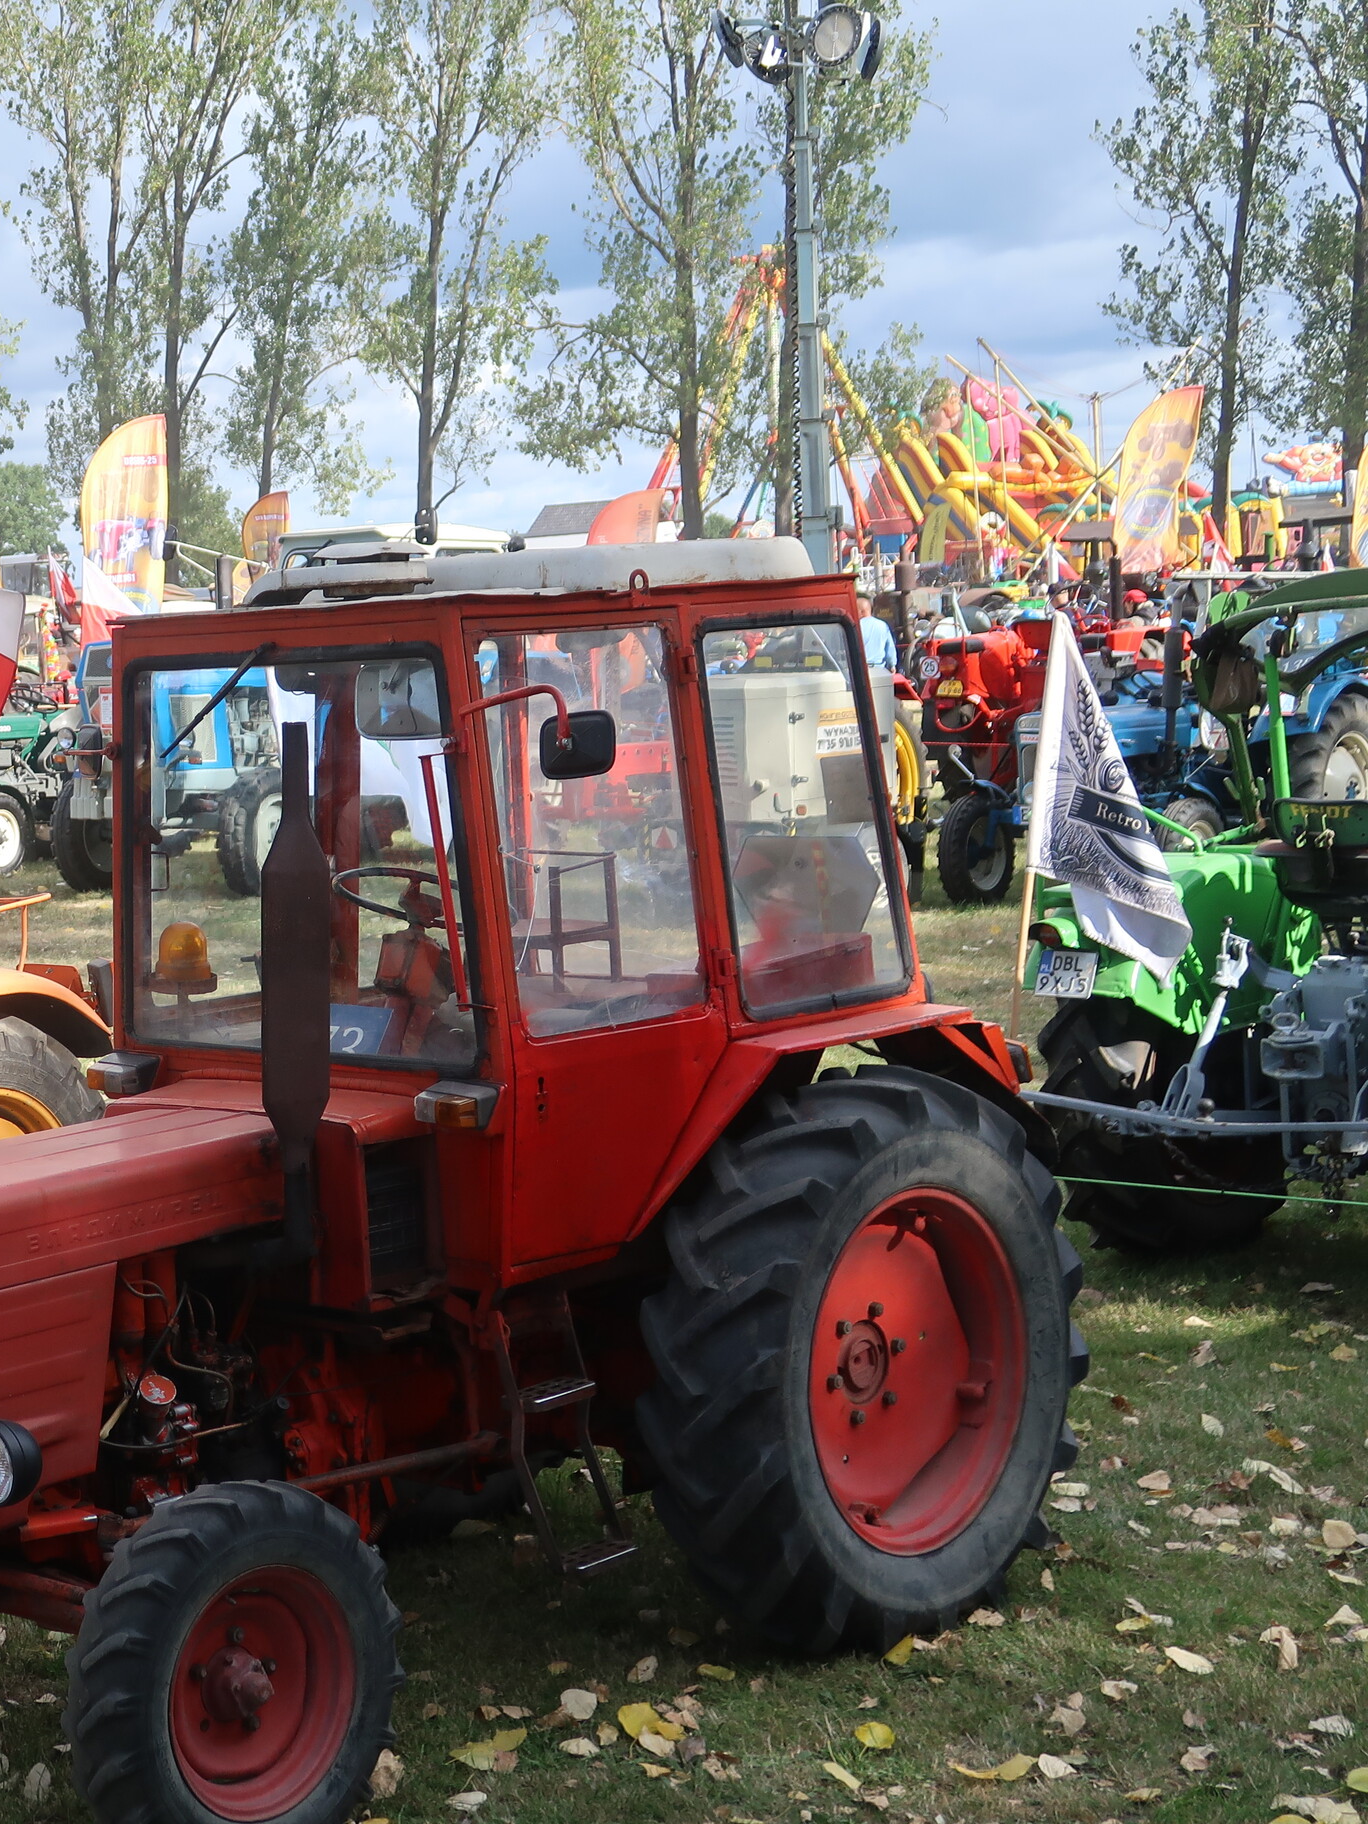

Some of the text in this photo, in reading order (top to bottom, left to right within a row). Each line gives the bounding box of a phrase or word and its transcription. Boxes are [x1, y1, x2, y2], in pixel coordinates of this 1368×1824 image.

[923, 661, 935, 672] 25
[1095, 802, 1142, 832] Retro
[1052, 955, 1083, 972] DBL
[1038, 975, 1087, 993] 9XJ5
